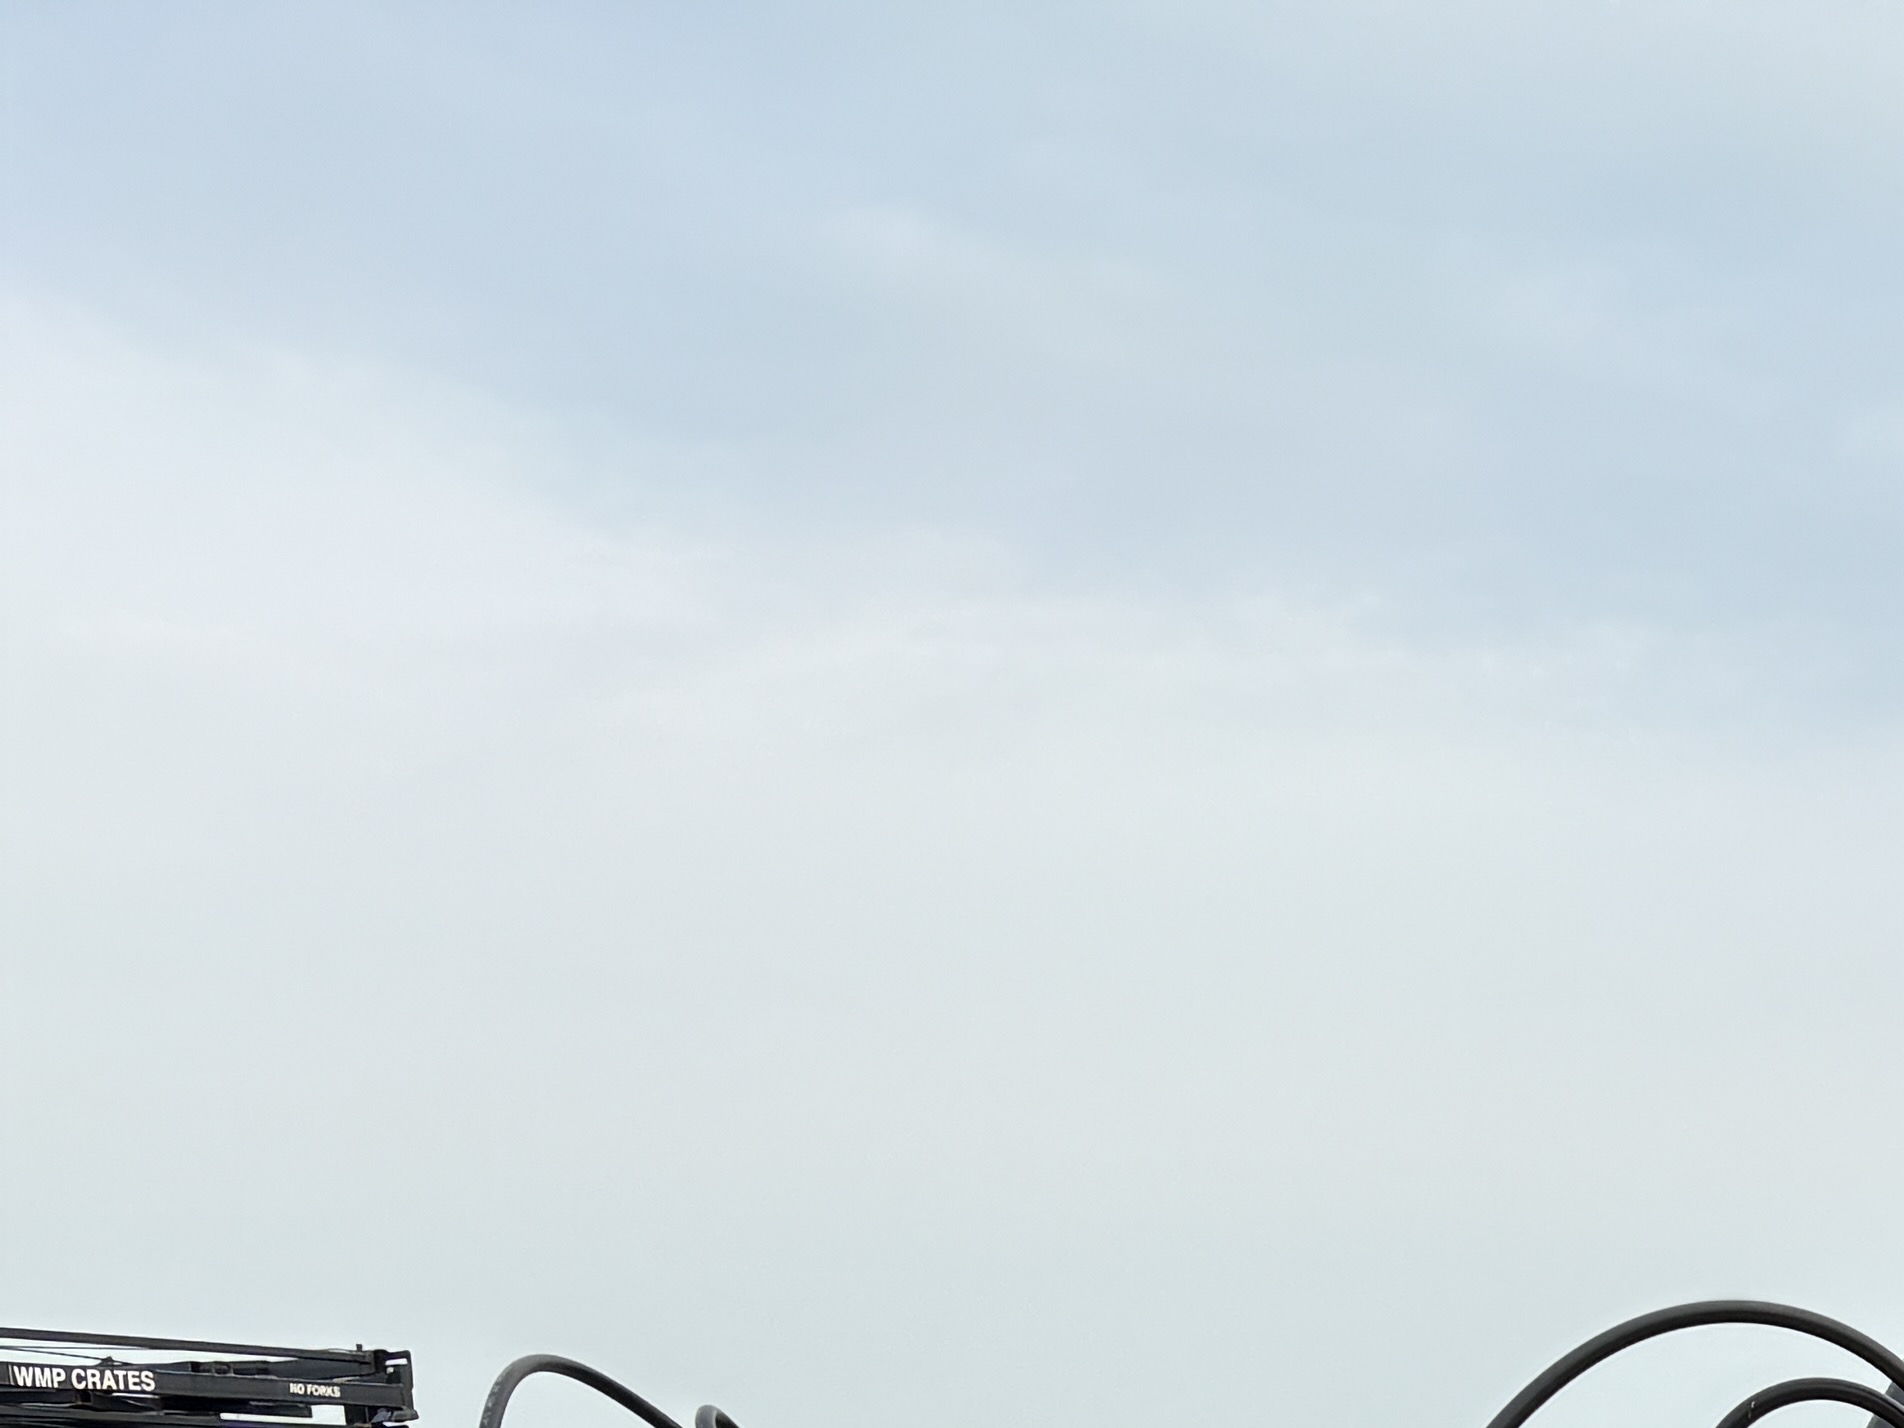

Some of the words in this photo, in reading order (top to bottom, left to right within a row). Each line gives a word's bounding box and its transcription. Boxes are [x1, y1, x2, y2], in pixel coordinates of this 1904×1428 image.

[14, 1365, 66, 1388] WMP
[71, 1369, 156, 1391] CRATES
[290, 1383, 305, 1394] NO
